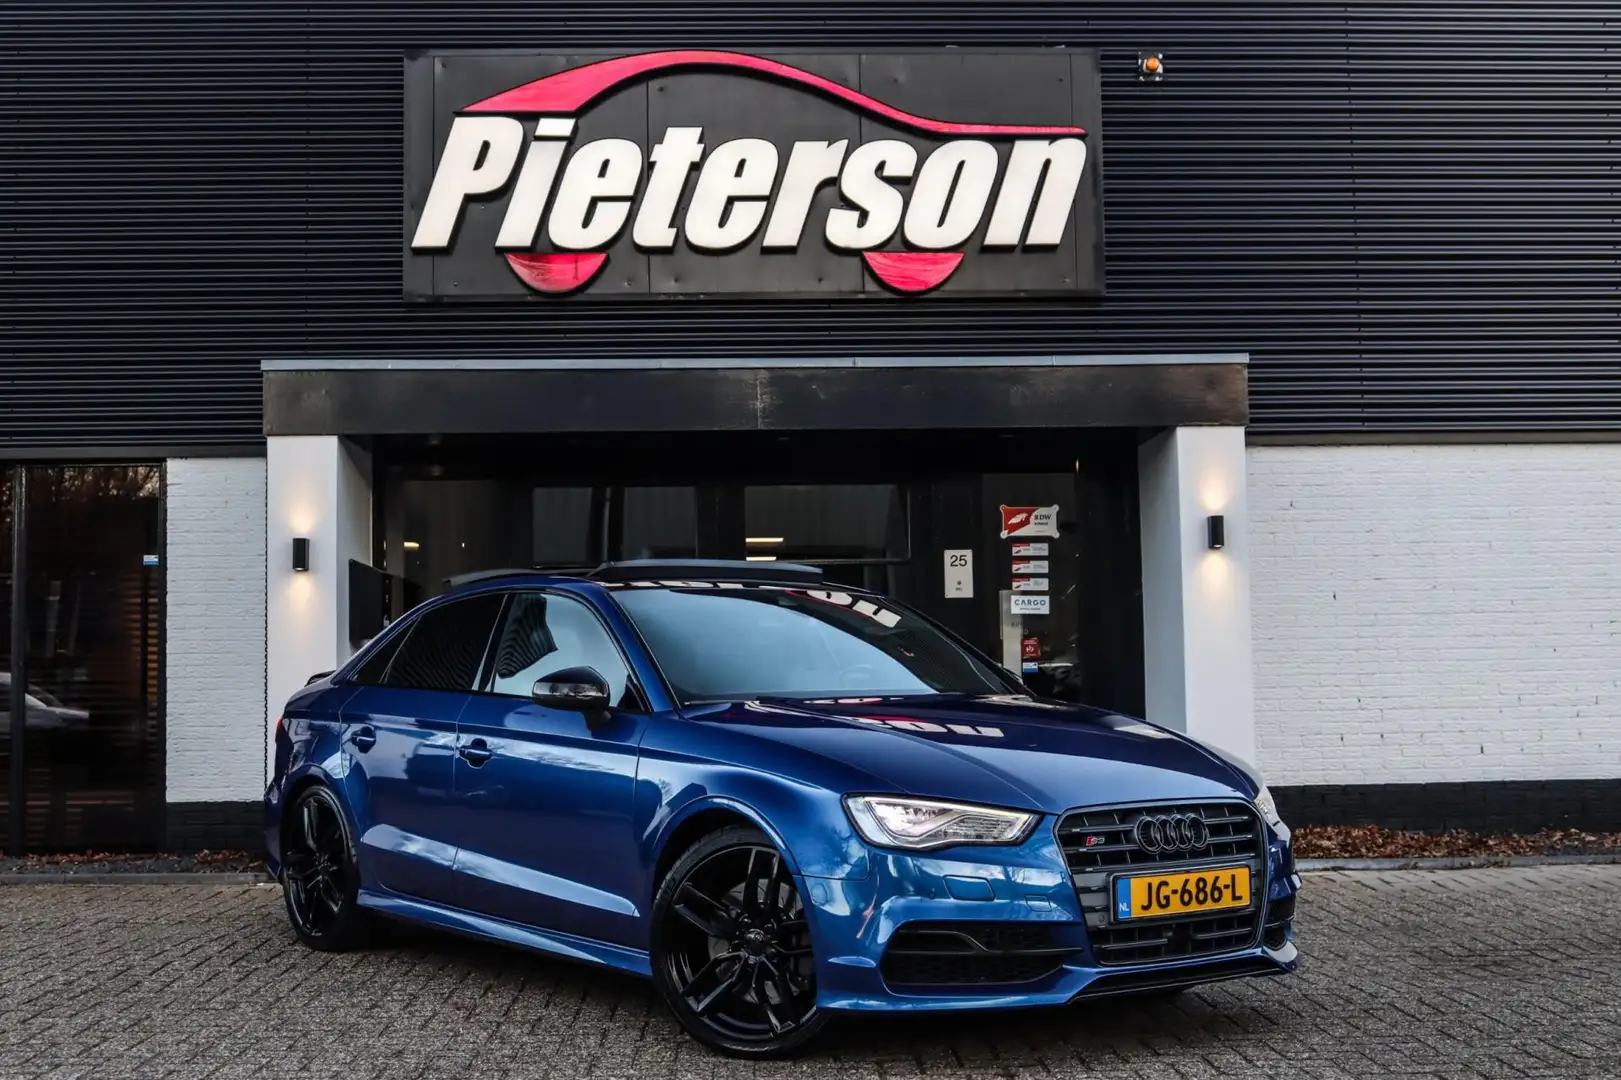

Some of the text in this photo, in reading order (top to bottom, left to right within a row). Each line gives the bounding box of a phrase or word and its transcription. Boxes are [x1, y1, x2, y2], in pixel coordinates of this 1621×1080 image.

[410, 116, 1088, 251] Pieterson
[950, 554, 968, 567] 25
[1141, 874, 1243, 911] JG-686-L
[1119, 903, 1129, 911] NL
